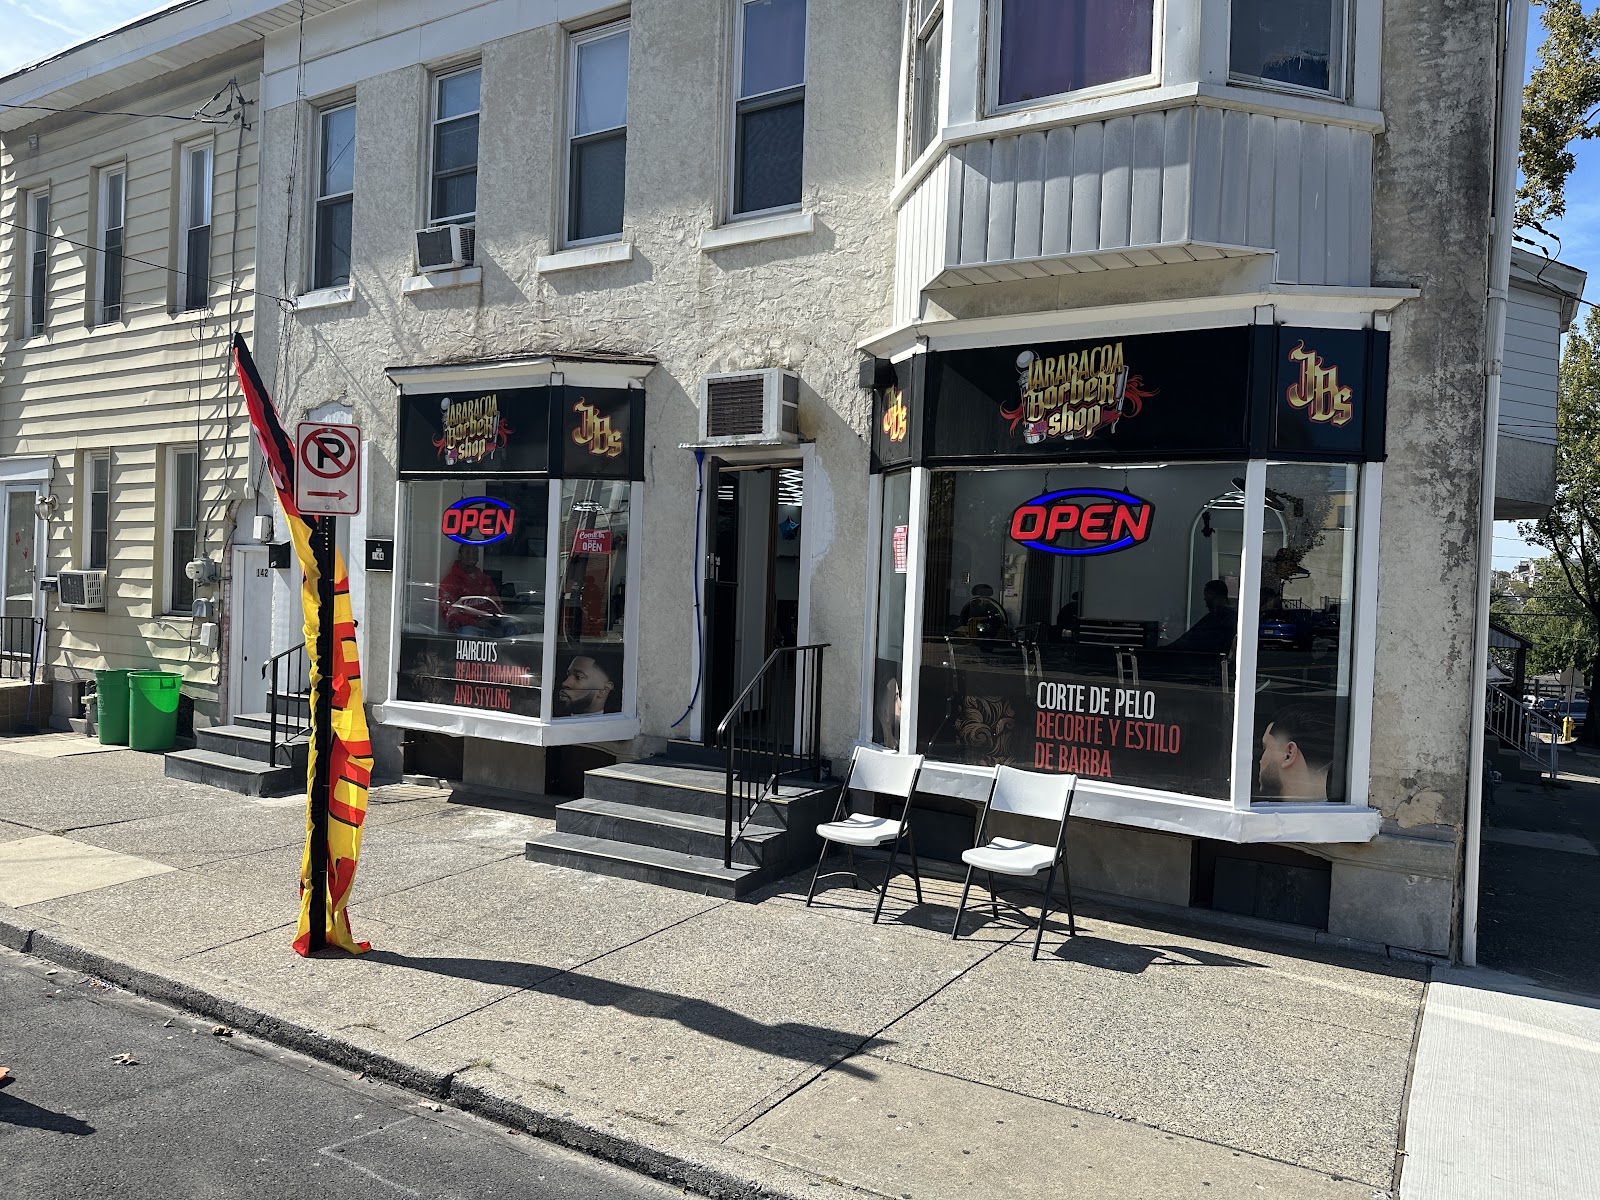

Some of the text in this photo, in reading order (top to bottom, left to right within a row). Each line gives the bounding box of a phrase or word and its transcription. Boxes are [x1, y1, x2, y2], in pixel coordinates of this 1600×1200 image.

[1048, 402, 1101, 437] shop
[317, 436, 345, 469] P
[458, 436, 486, 461] shop
[442, 509, 515, 535] OPEN
[1010, 504, 1151, 541] OPEN
[582, 542, 602, 552] OPEN
[257, 568, 269, 577] 142
[456, 640, 498, 662] HAIRCUTS
[456, 662, 531, 686] BEARD TRIMMING
[454, 685, 511, 709] AND STYLING
[1037, 681, 1155, 720] CORTE DE PELO
[1036, 711, 1181, 754] RECORTE Y ESTILO
[1034, 742, 1112, 778] DE BARBA
